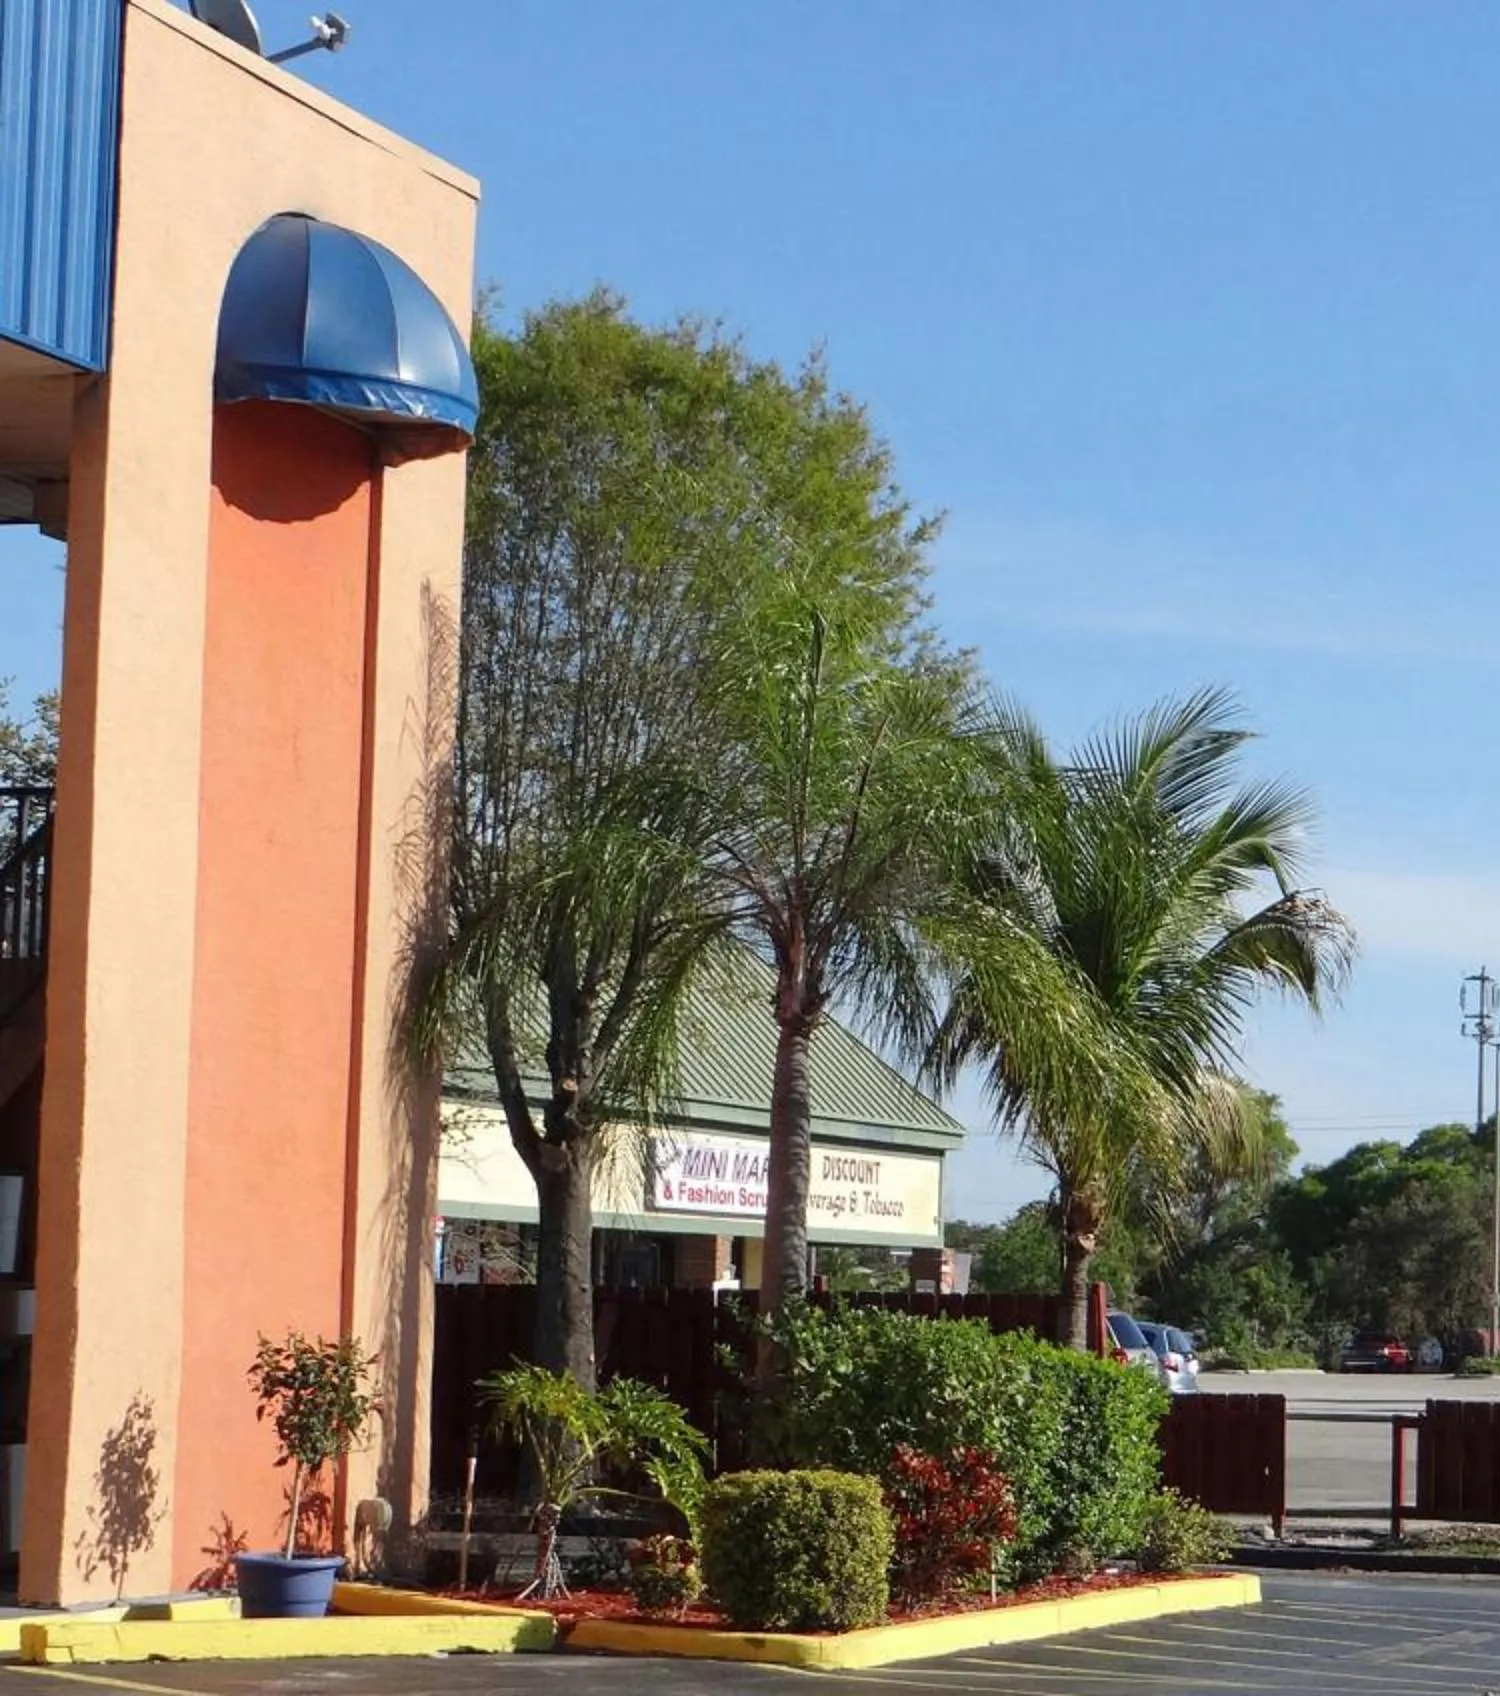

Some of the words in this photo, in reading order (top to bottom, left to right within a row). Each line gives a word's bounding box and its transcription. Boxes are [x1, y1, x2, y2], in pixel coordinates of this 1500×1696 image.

[683, 1147, 729, 1179] MINI
[732, 1152, 769, 1184] MAR
[822, 1155, 881, 1185] DISCOUNT
[663, 1181, 673, 1201] &
[678, 1181, 735, 1205] Fashion
[862, 1191, 904, 1217] Tobacco
